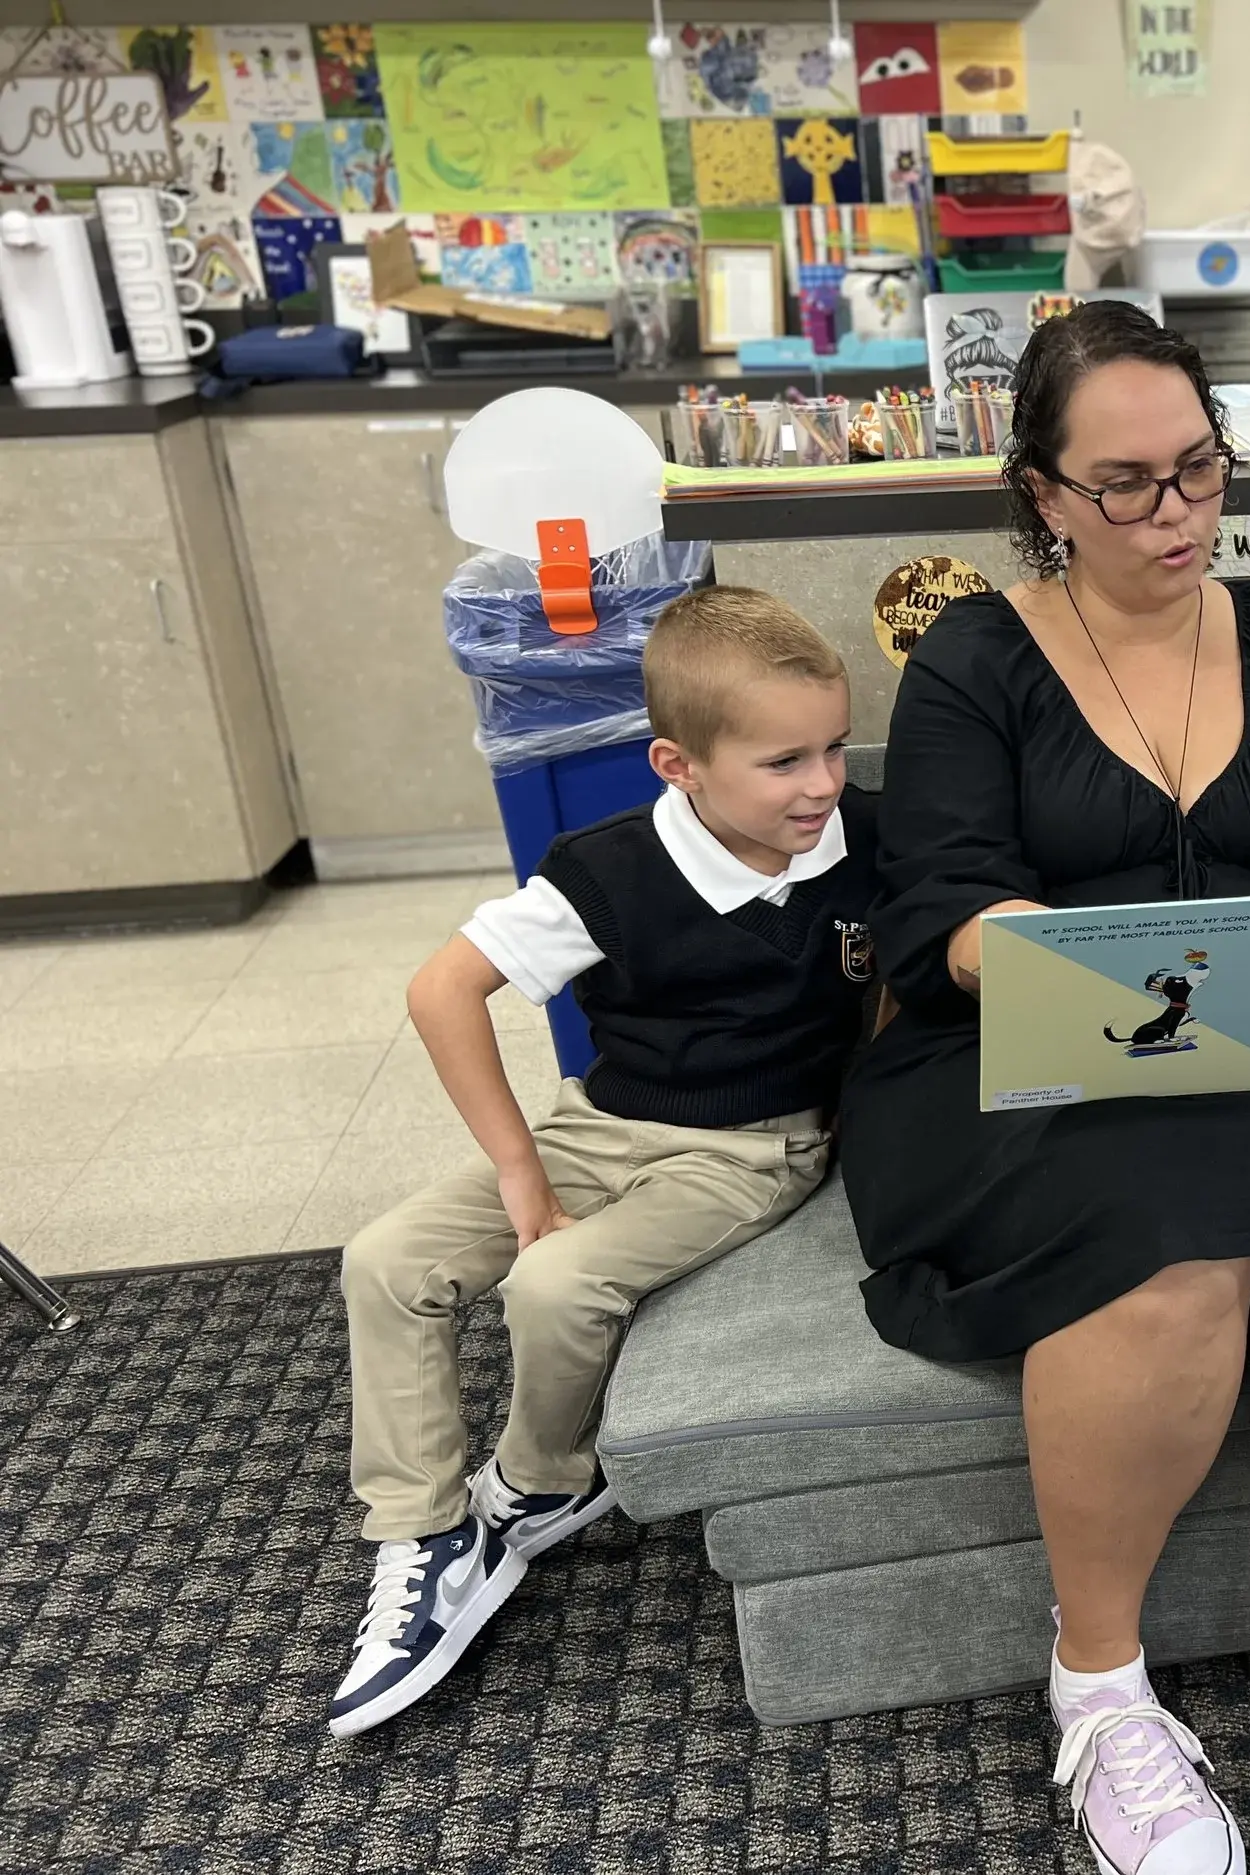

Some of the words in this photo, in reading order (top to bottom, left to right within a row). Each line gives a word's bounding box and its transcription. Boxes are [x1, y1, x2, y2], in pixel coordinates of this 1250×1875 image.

[1137, 48, 1199, 79] WORLD
[109, 150, 170, 181] BAR
[1061, 925, 1103, 934] SCHOOL
[1135, 920, 1171, 929] AMAZE
[1175, 918, 1199, 926] YOU.
[1074, 935, 1095, 943] FAR
[1098, 934, 1118, 942] THE
[1120, 932, 1150, 940] MOST
[1152, 927, 1205, 937] FABULOUS
[1208, 925, 1249, 934] SCHOOL
[1002, 1096, 1039, 1105] Panther
[1041, 1093, 1073, 1101] House
[1011, 1088, 1052, 1097] Property
